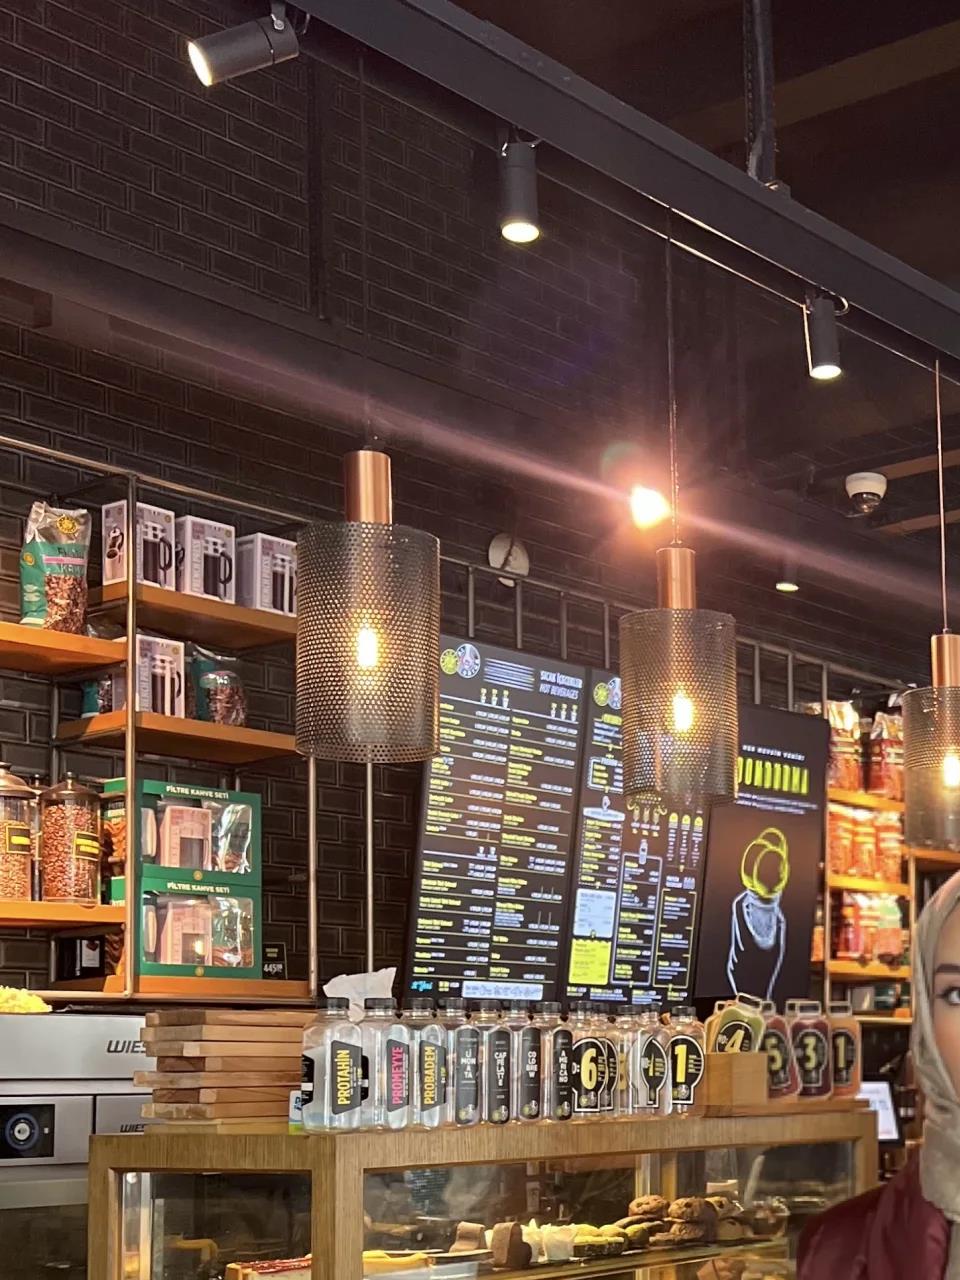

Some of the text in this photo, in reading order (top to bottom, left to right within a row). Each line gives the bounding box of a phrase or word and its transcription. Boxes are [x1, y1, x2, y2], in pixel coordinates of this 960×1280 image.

[335, 1049, 351, 1105] PROTAHİN
[391, 1046, 403, 1104] PROMEYVE
[423, 1046, 436, 1104] PROBADEM
[803, 1036, 816, 1070] 3
